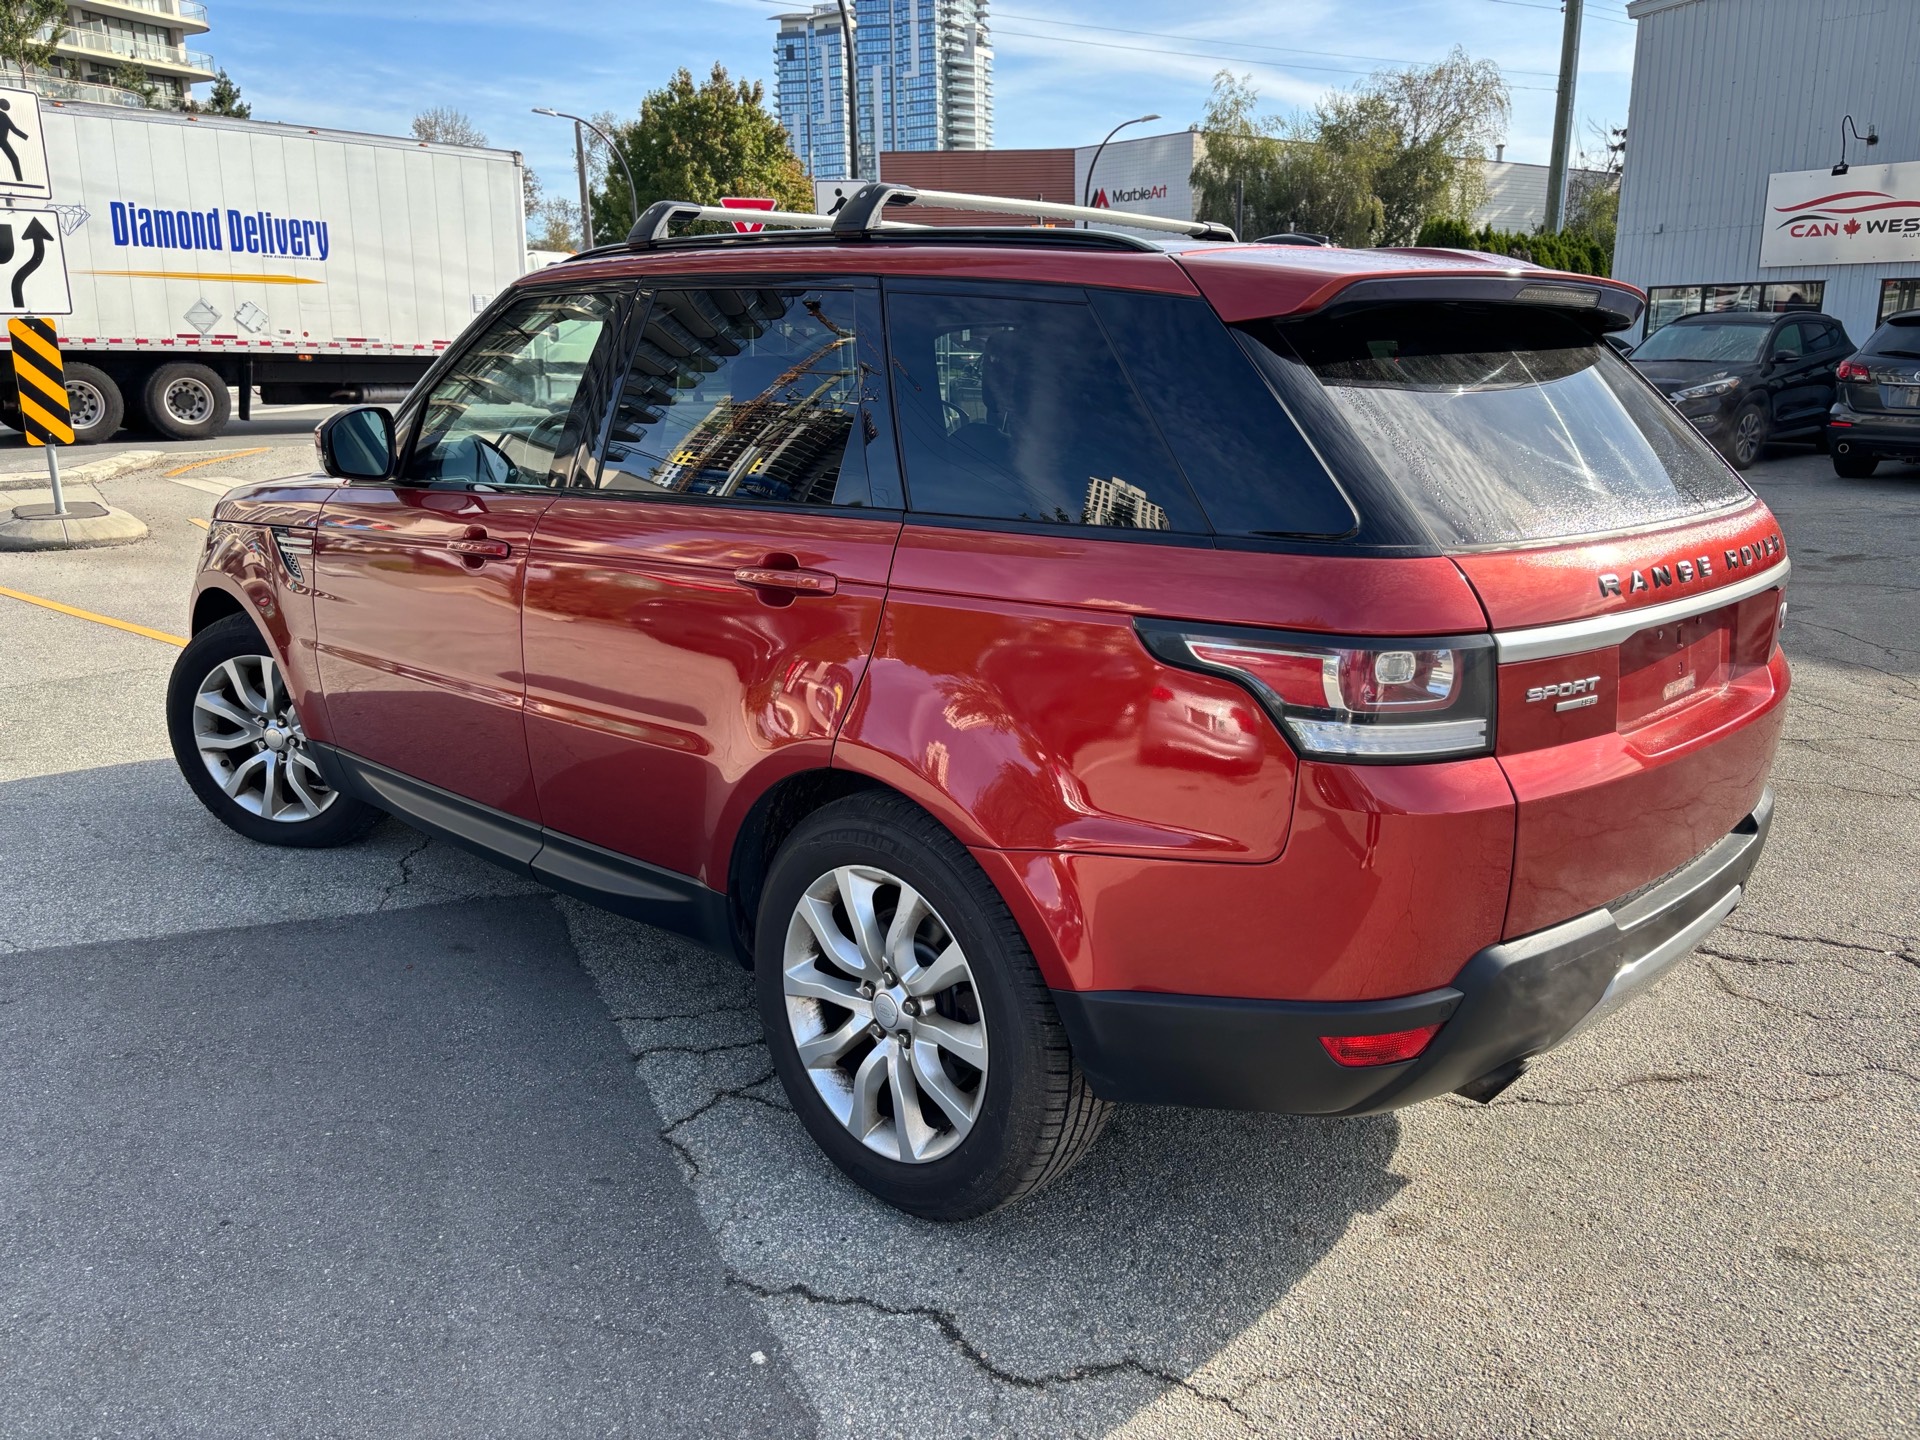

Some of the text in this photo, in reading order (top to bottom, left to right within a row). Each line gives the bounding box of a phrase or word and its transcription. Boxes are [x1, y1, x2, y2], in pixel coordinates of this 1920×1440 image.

[1112, 184, 1167, 203] MarbleArt
[110, 202, 329, 261] Diamond Delivery
[1790, 223, 1839, 238] CAN
[1598, 534, 1780, 598] RANGE ROVER
[1525, 675, 1601, 703] SPORT
